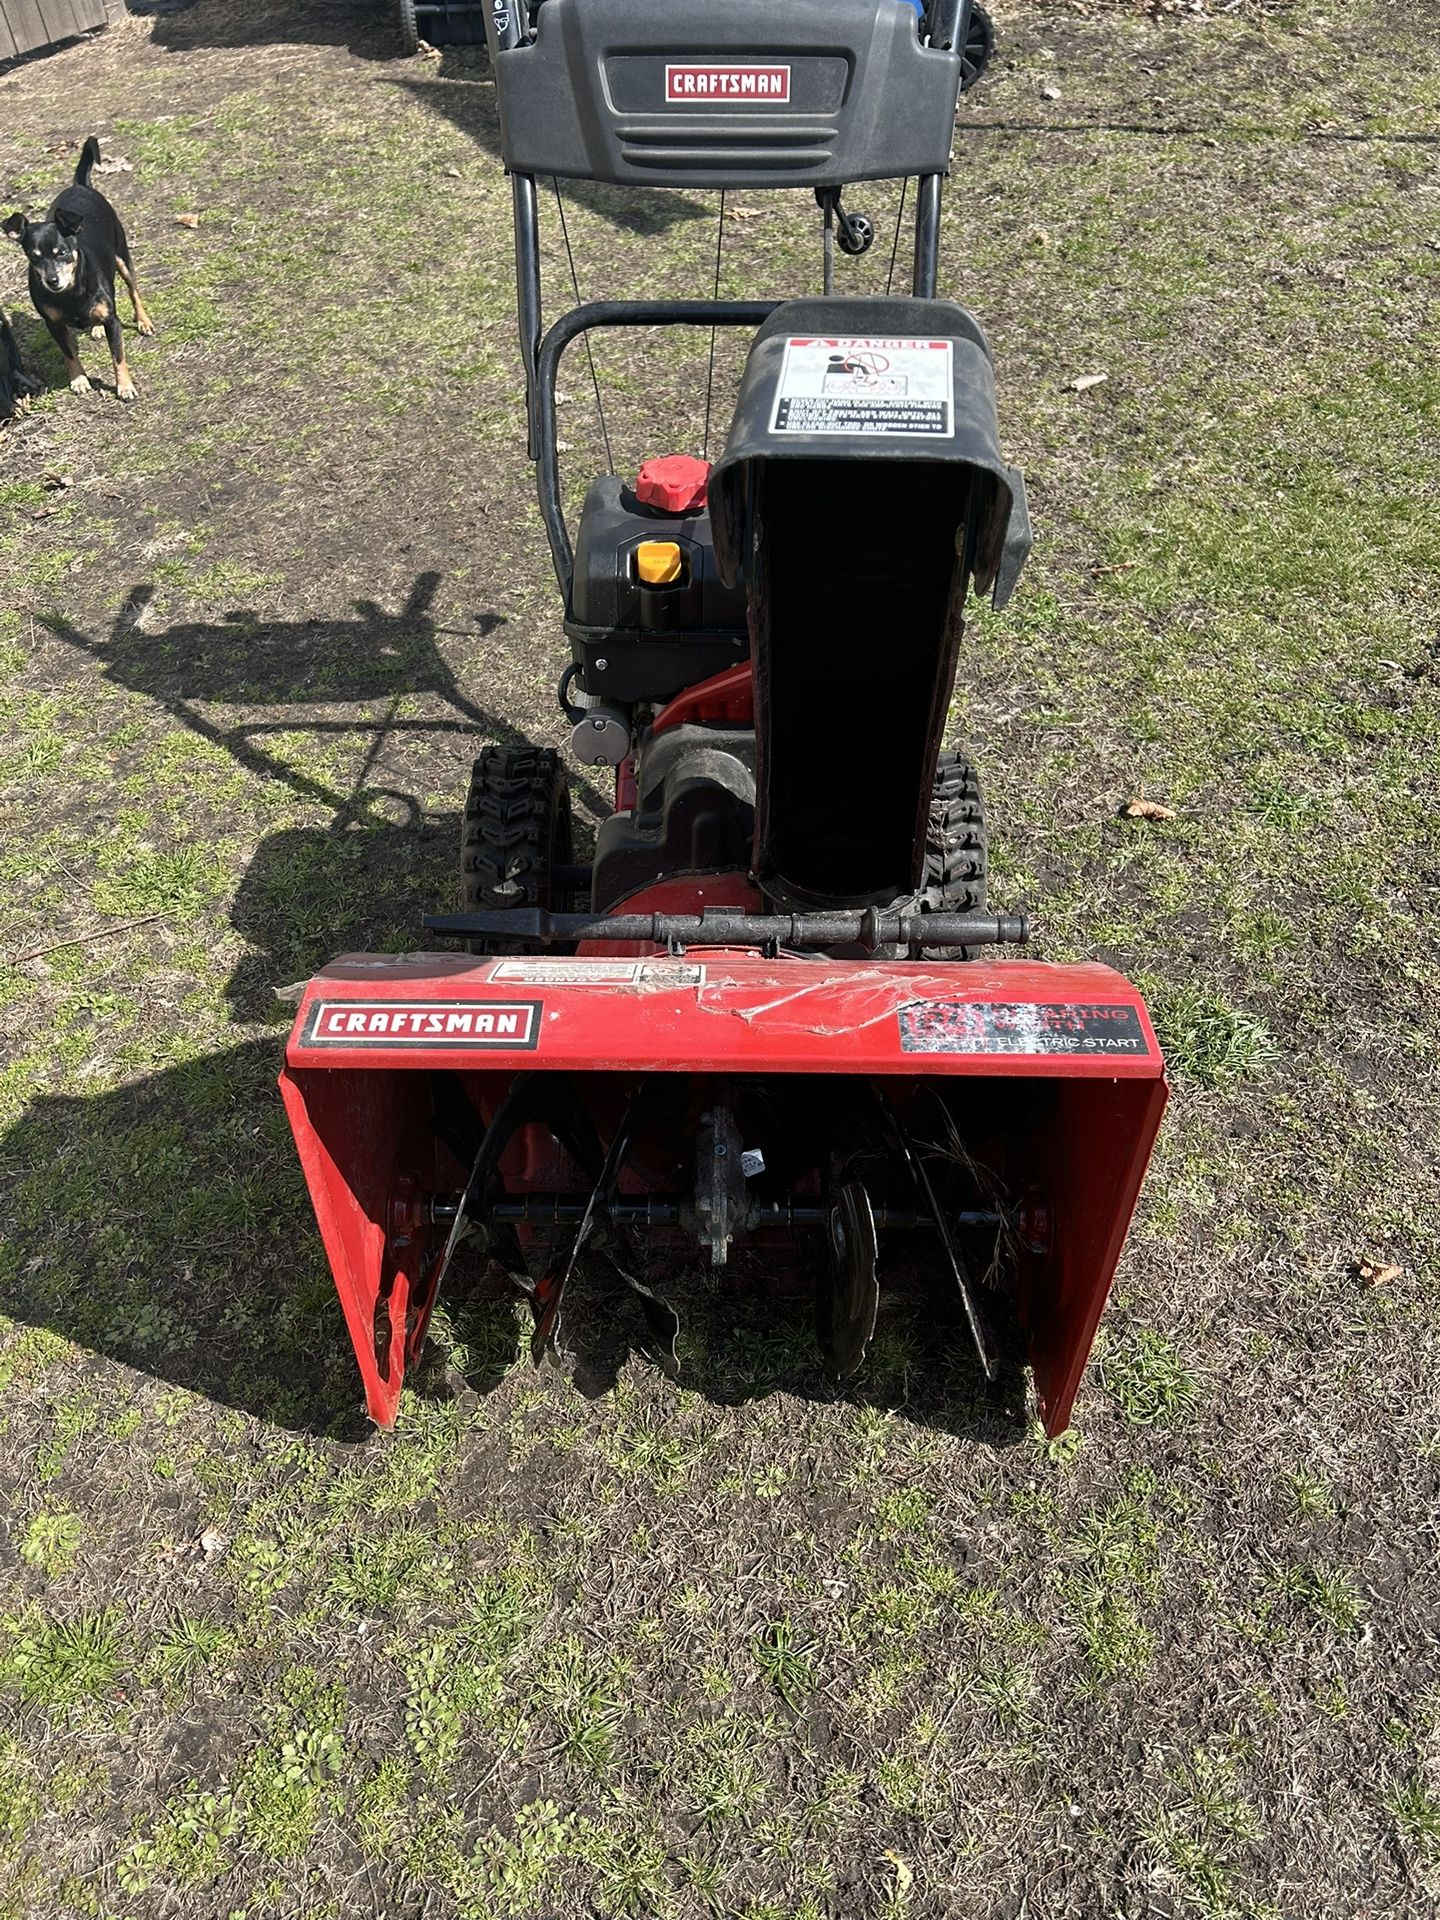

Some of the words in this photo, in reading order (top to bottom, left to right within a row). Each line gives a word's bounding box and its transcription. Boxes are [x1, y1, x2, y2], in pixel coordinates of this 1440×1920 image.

[673, 74, 782, 93] CRAFTSMAN
[838, 340, 930, 349] DANGER
[327, 1013, 518, 1033] CRAFTSMAN
[1085, 1038, 1140, 1048] START
